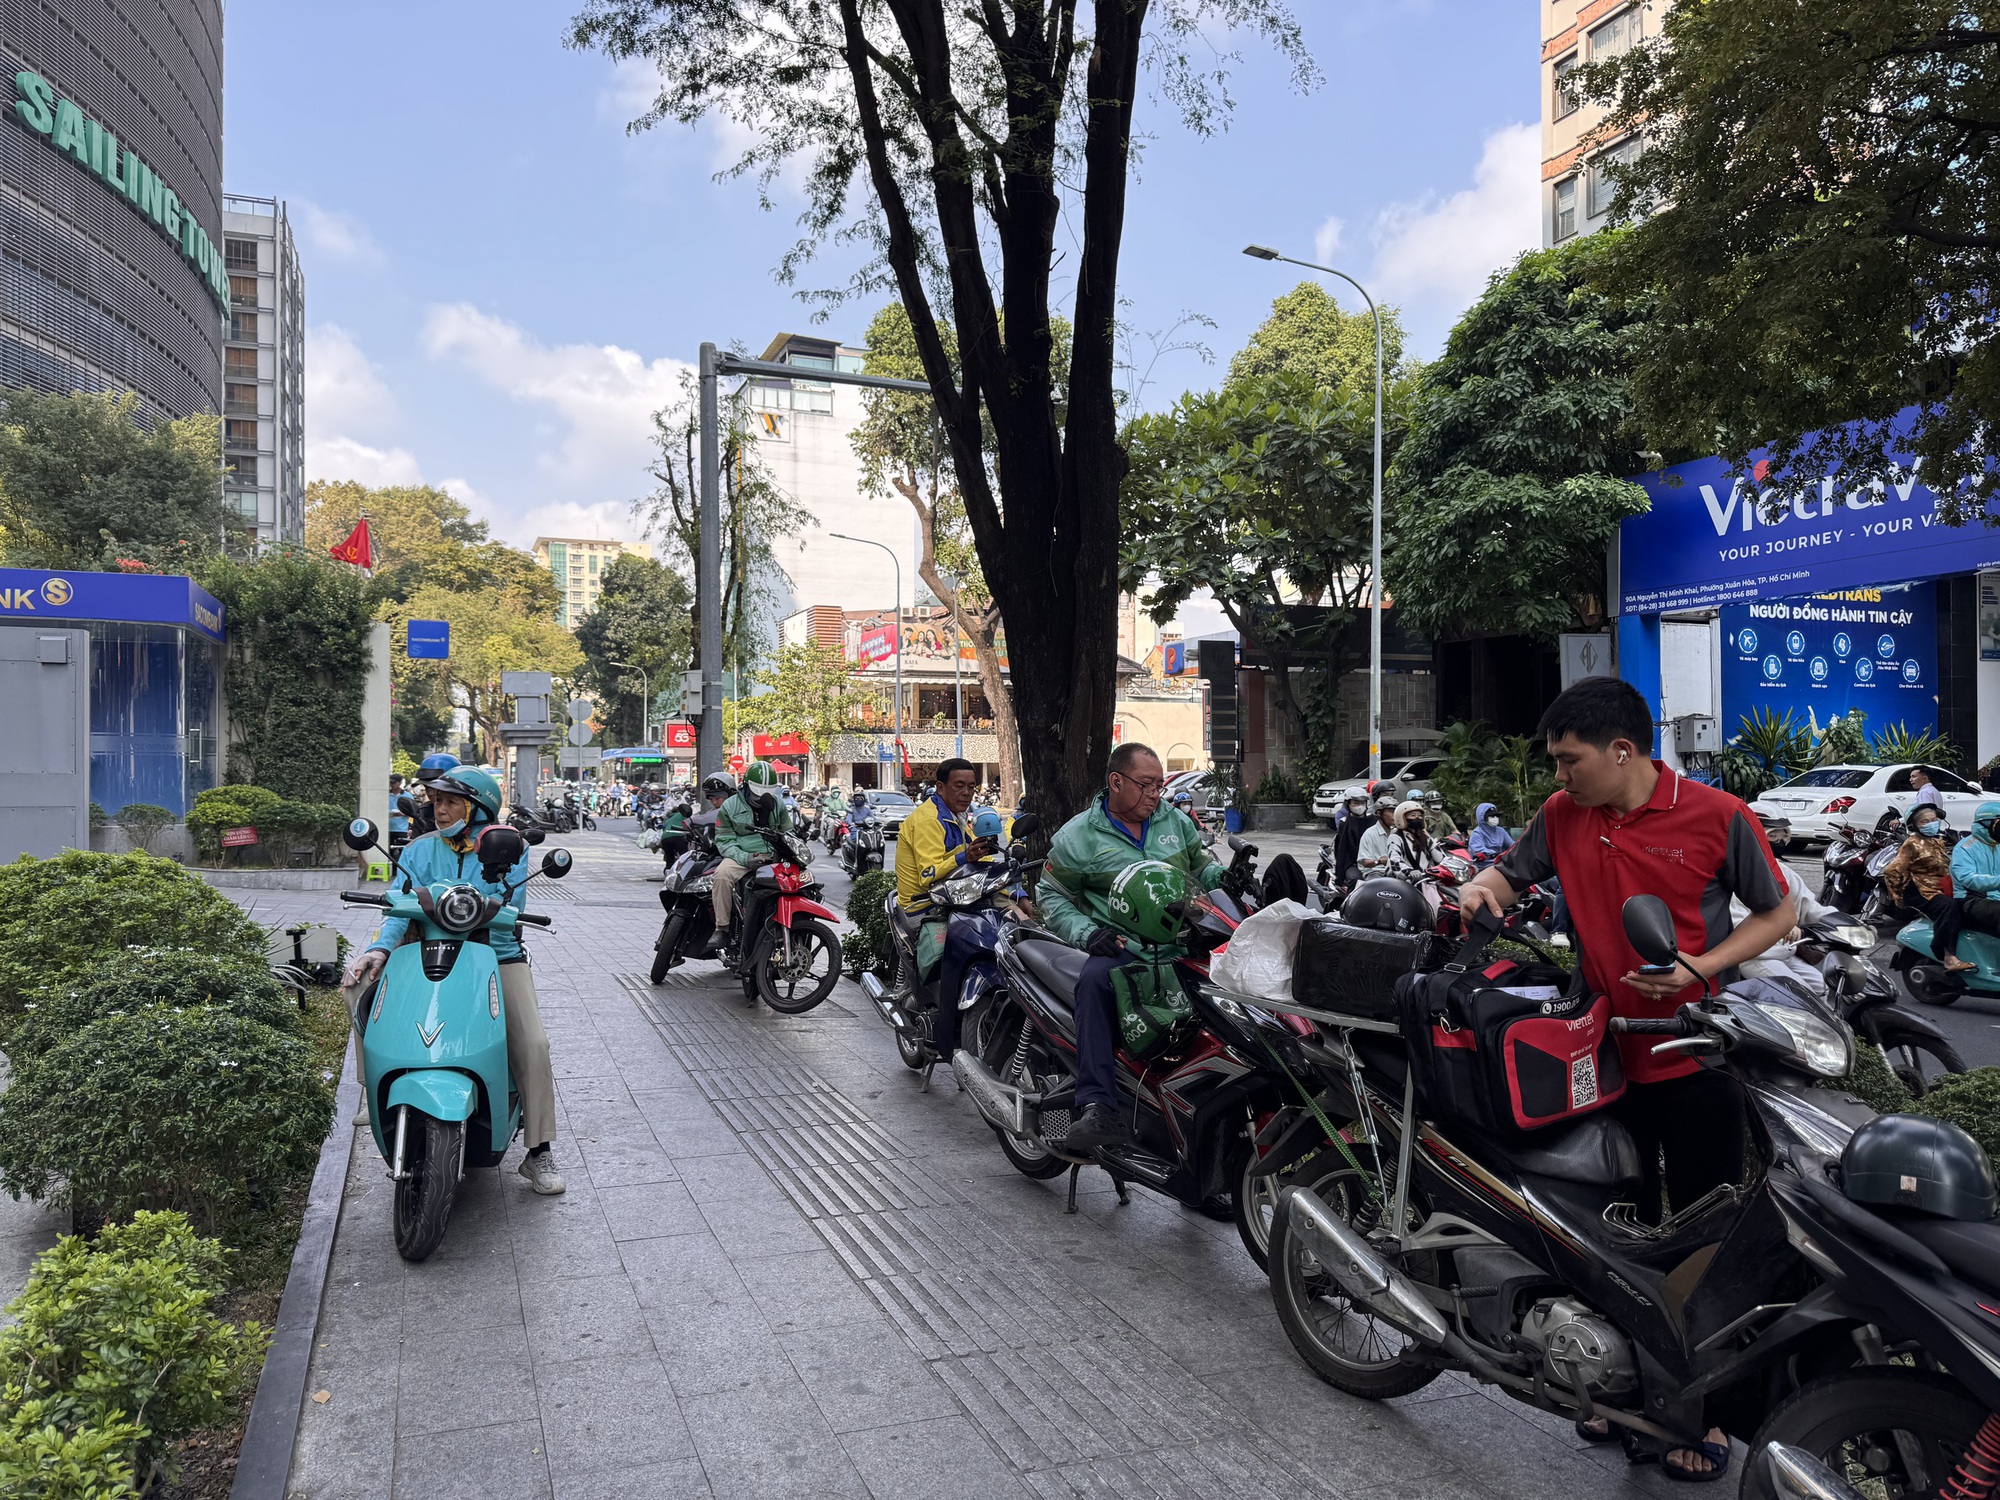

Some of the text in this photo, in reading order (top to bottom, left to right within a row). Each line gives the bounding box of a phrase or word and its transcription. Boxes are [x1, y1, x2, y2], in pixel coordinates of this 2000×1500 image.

[15, 71, 181, 242] SAILING
[1718, 544, 1760, 562] YOUR
[1765, 529, 1844, 555] JOURNEY
[1862, 517, 1913, 538] YOUR
[1792, 570, 1810, 579] Minh
[1749, 602, 1913, 627] NGƯỜI ĐỒNG HÀNH TIN CẬY
[674, 731, 691, 743] 5G
